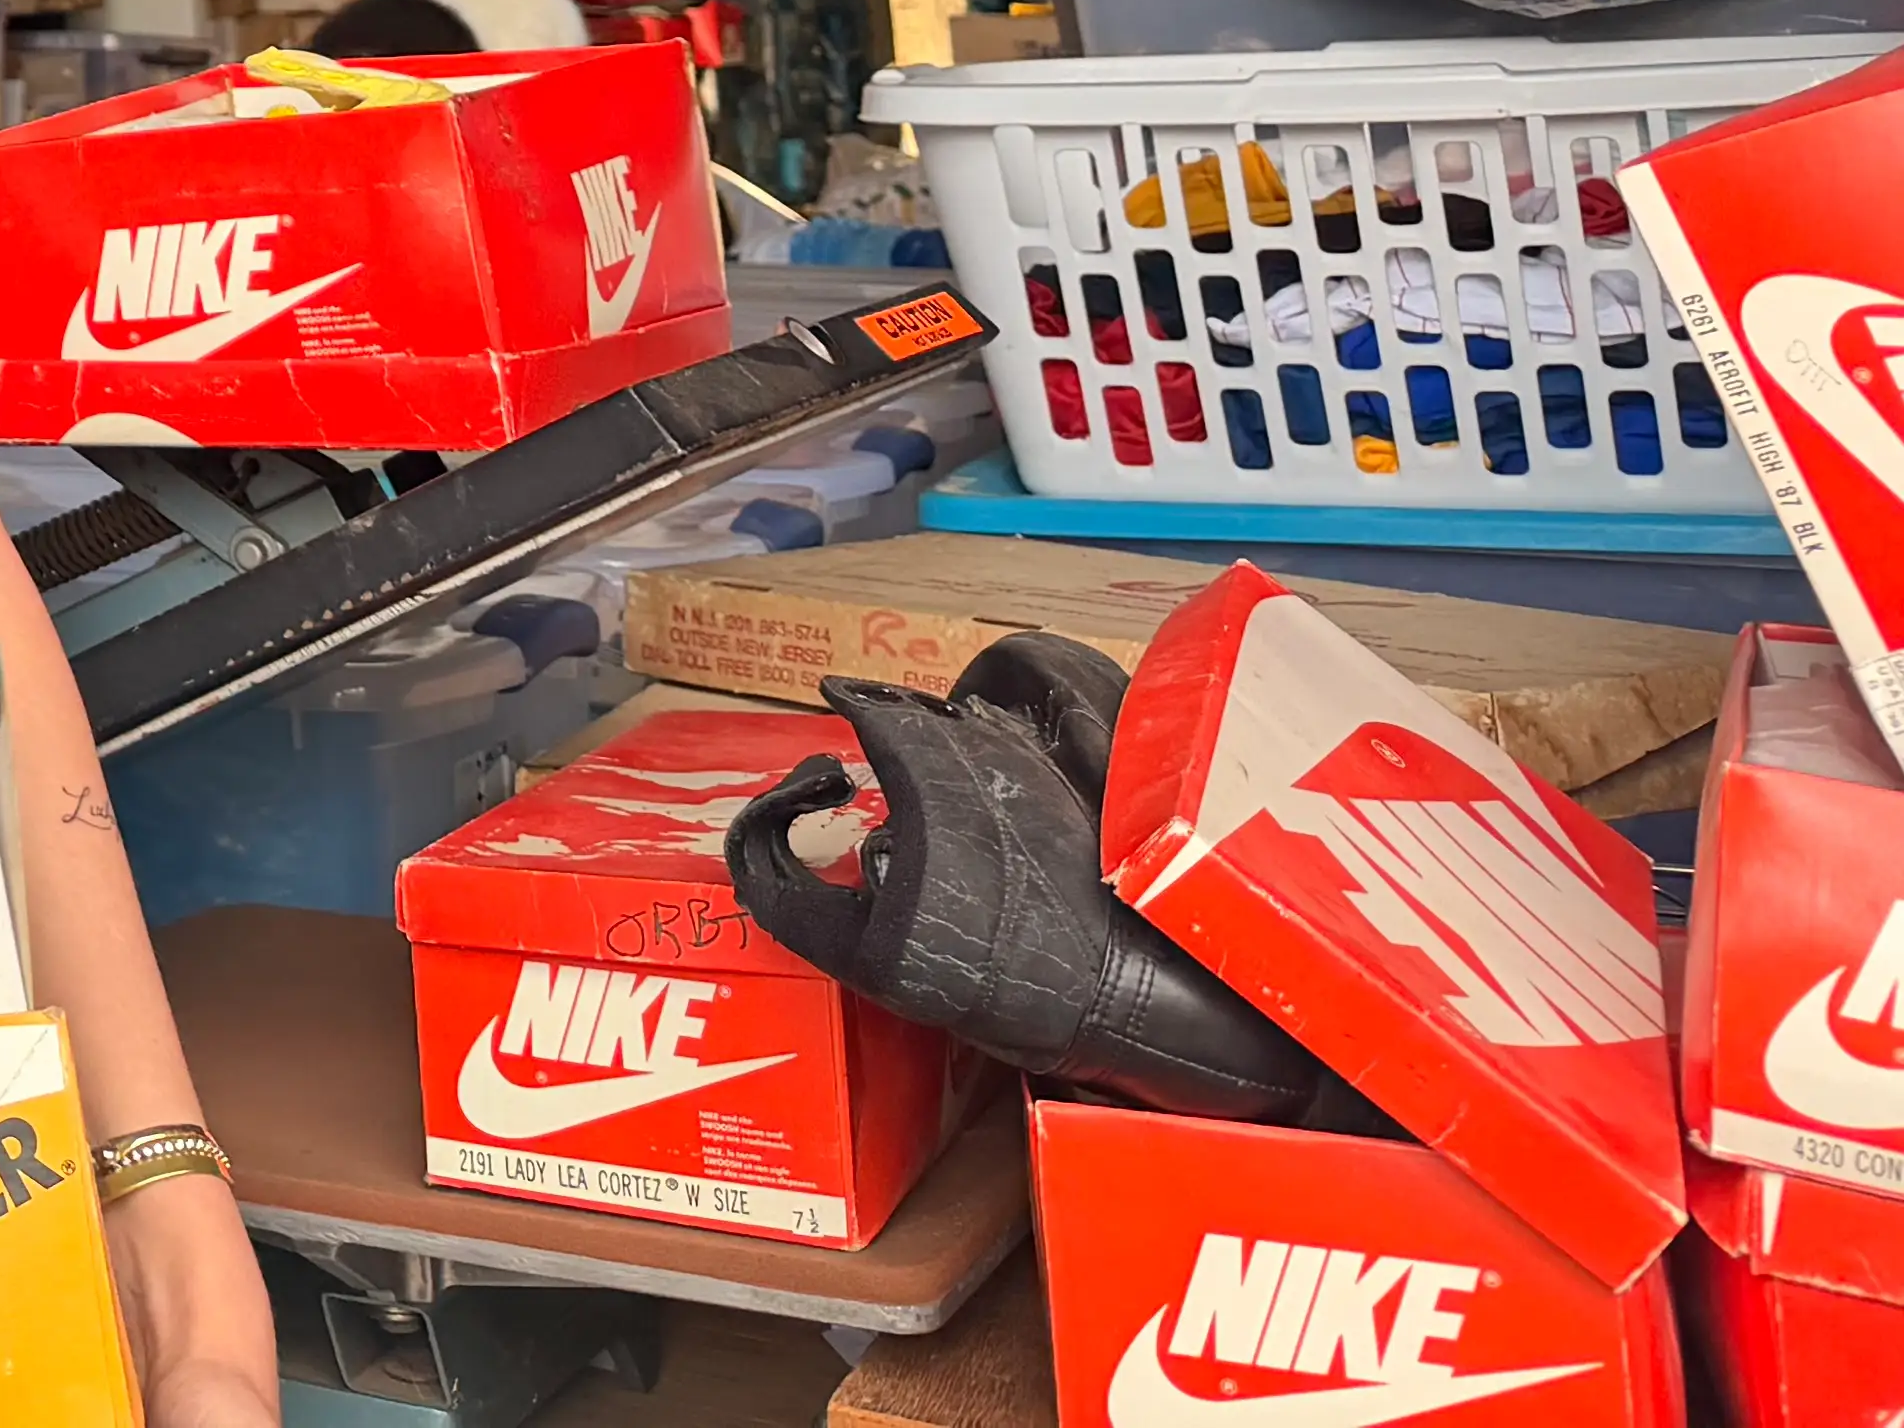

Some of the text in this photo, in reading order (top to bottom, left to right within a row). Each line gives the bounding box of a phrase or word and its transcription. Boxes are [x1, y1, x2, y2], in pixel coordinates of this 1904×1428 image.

[570, 154, 643, 272] NIKE
[93, 214, 280, 323] NIKE
[876, 299, 953, 339] CAUTION
[1681, 293, 1719, 337] 6261
[1707, 350, 1760, 417] AEROFIT
[1792, 522, 1825, 556] BLK
[669, 627, 835, 667] OUTSIDE NEW JERSEY
[676, 649, 713, 672] TOLL
[716, 652, 754, 679] FREE
[498, 960, 718, 1074] NIKE
[459, 1148, 494, 1178] 2191
[505, 1155, 547, 1185] LADY
[557, 1164, 589, 1191] LEA
[685, 1183, 700, 1207] W
[714, 1187, 751, 1216] SIZE
[1792, 1135, 1845, 1169] 4320
[1168, 1231, 1482, 1386] NIKE
